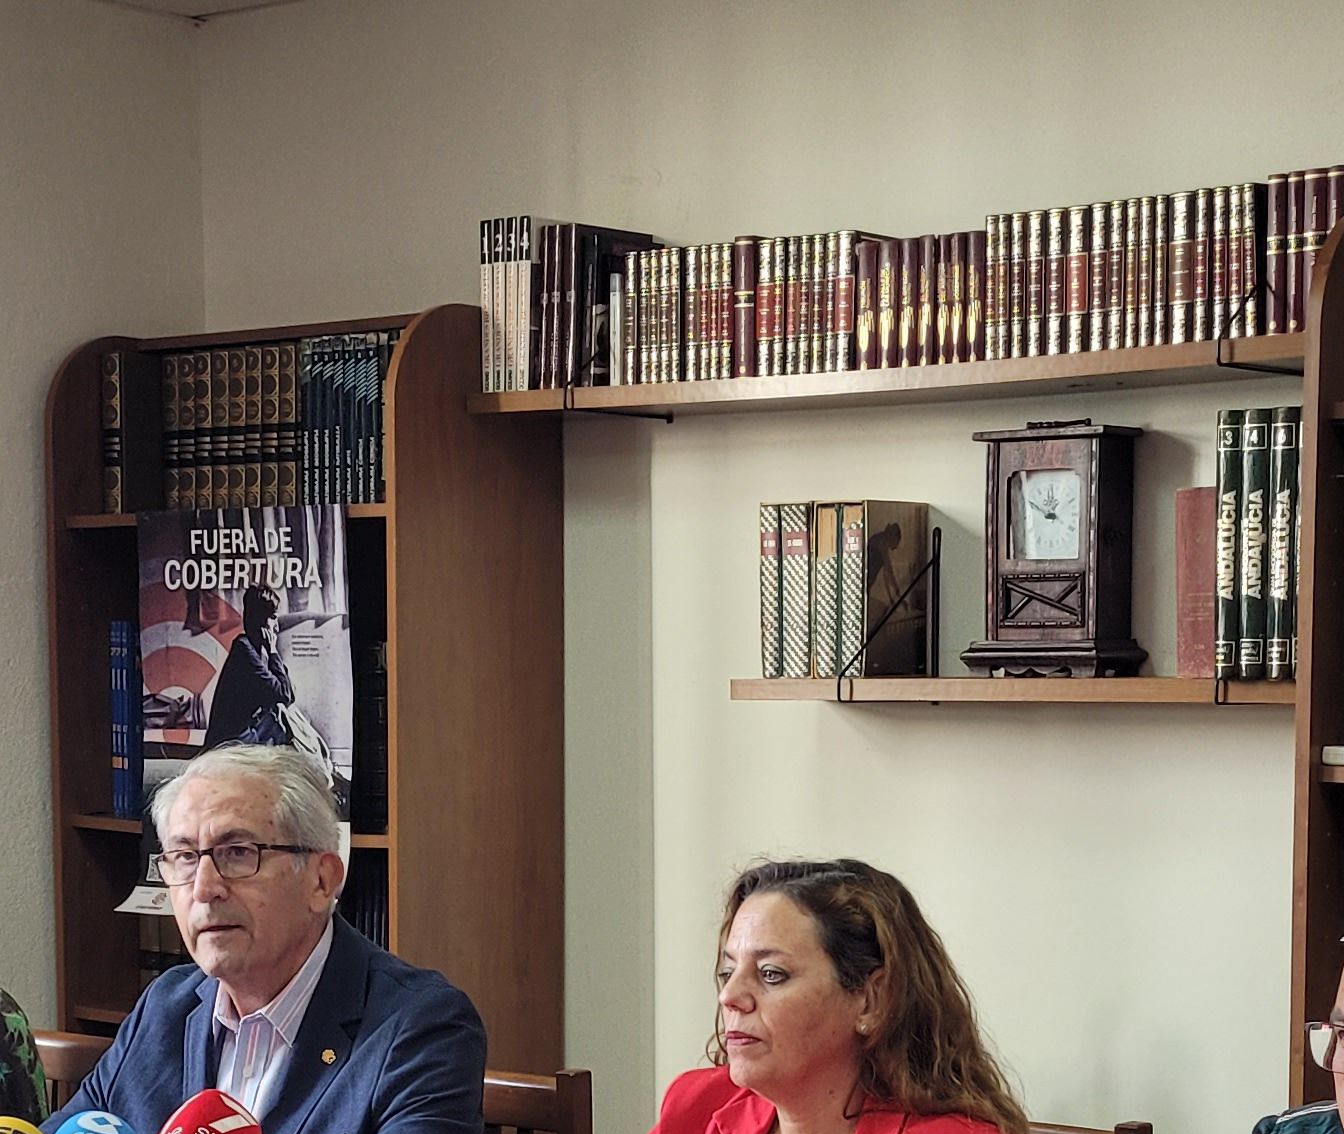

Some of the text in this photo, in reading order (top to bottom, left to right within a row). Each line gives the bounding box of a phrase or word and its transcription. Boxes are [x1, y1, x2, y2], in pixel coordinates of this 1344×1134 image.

[1222, 431, 1233, 445] 3
[1250, 430, 1259, 445] 4
[1277, 428, 1287, 444] 6
[190, 527, 292, 555] FUERA DE
[164, 558, 322, 591] COBERTURA
